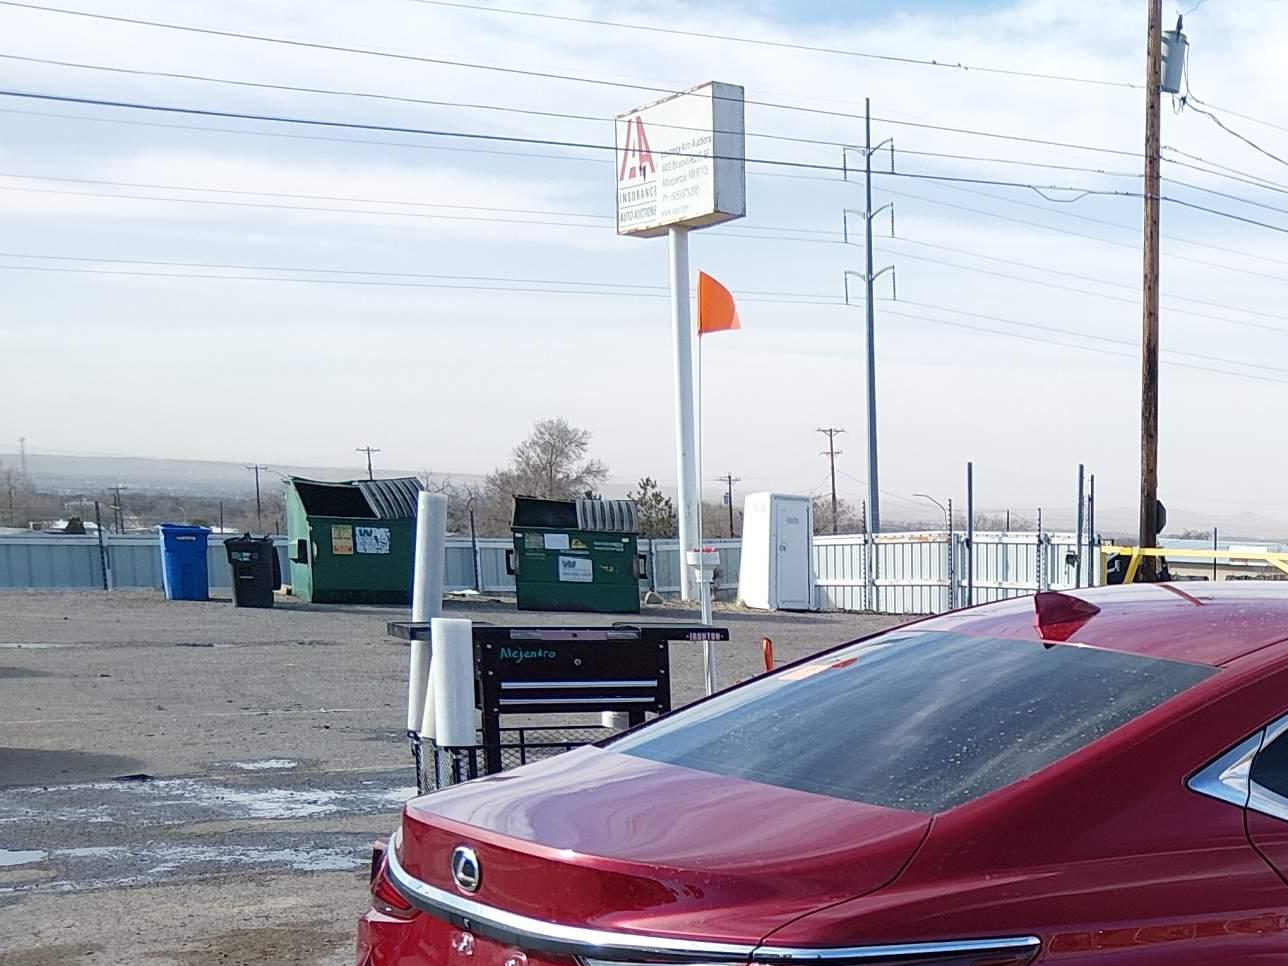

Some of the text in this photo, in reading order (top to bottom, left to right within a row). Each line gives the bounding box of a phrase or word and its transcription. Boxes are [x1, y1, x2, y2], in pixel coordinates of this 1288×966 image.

[619, 184, 657, 205] INSURANCE
[689, 632, 721, 641] IRONTON
[500, 646, 557, 664] Alejandro
